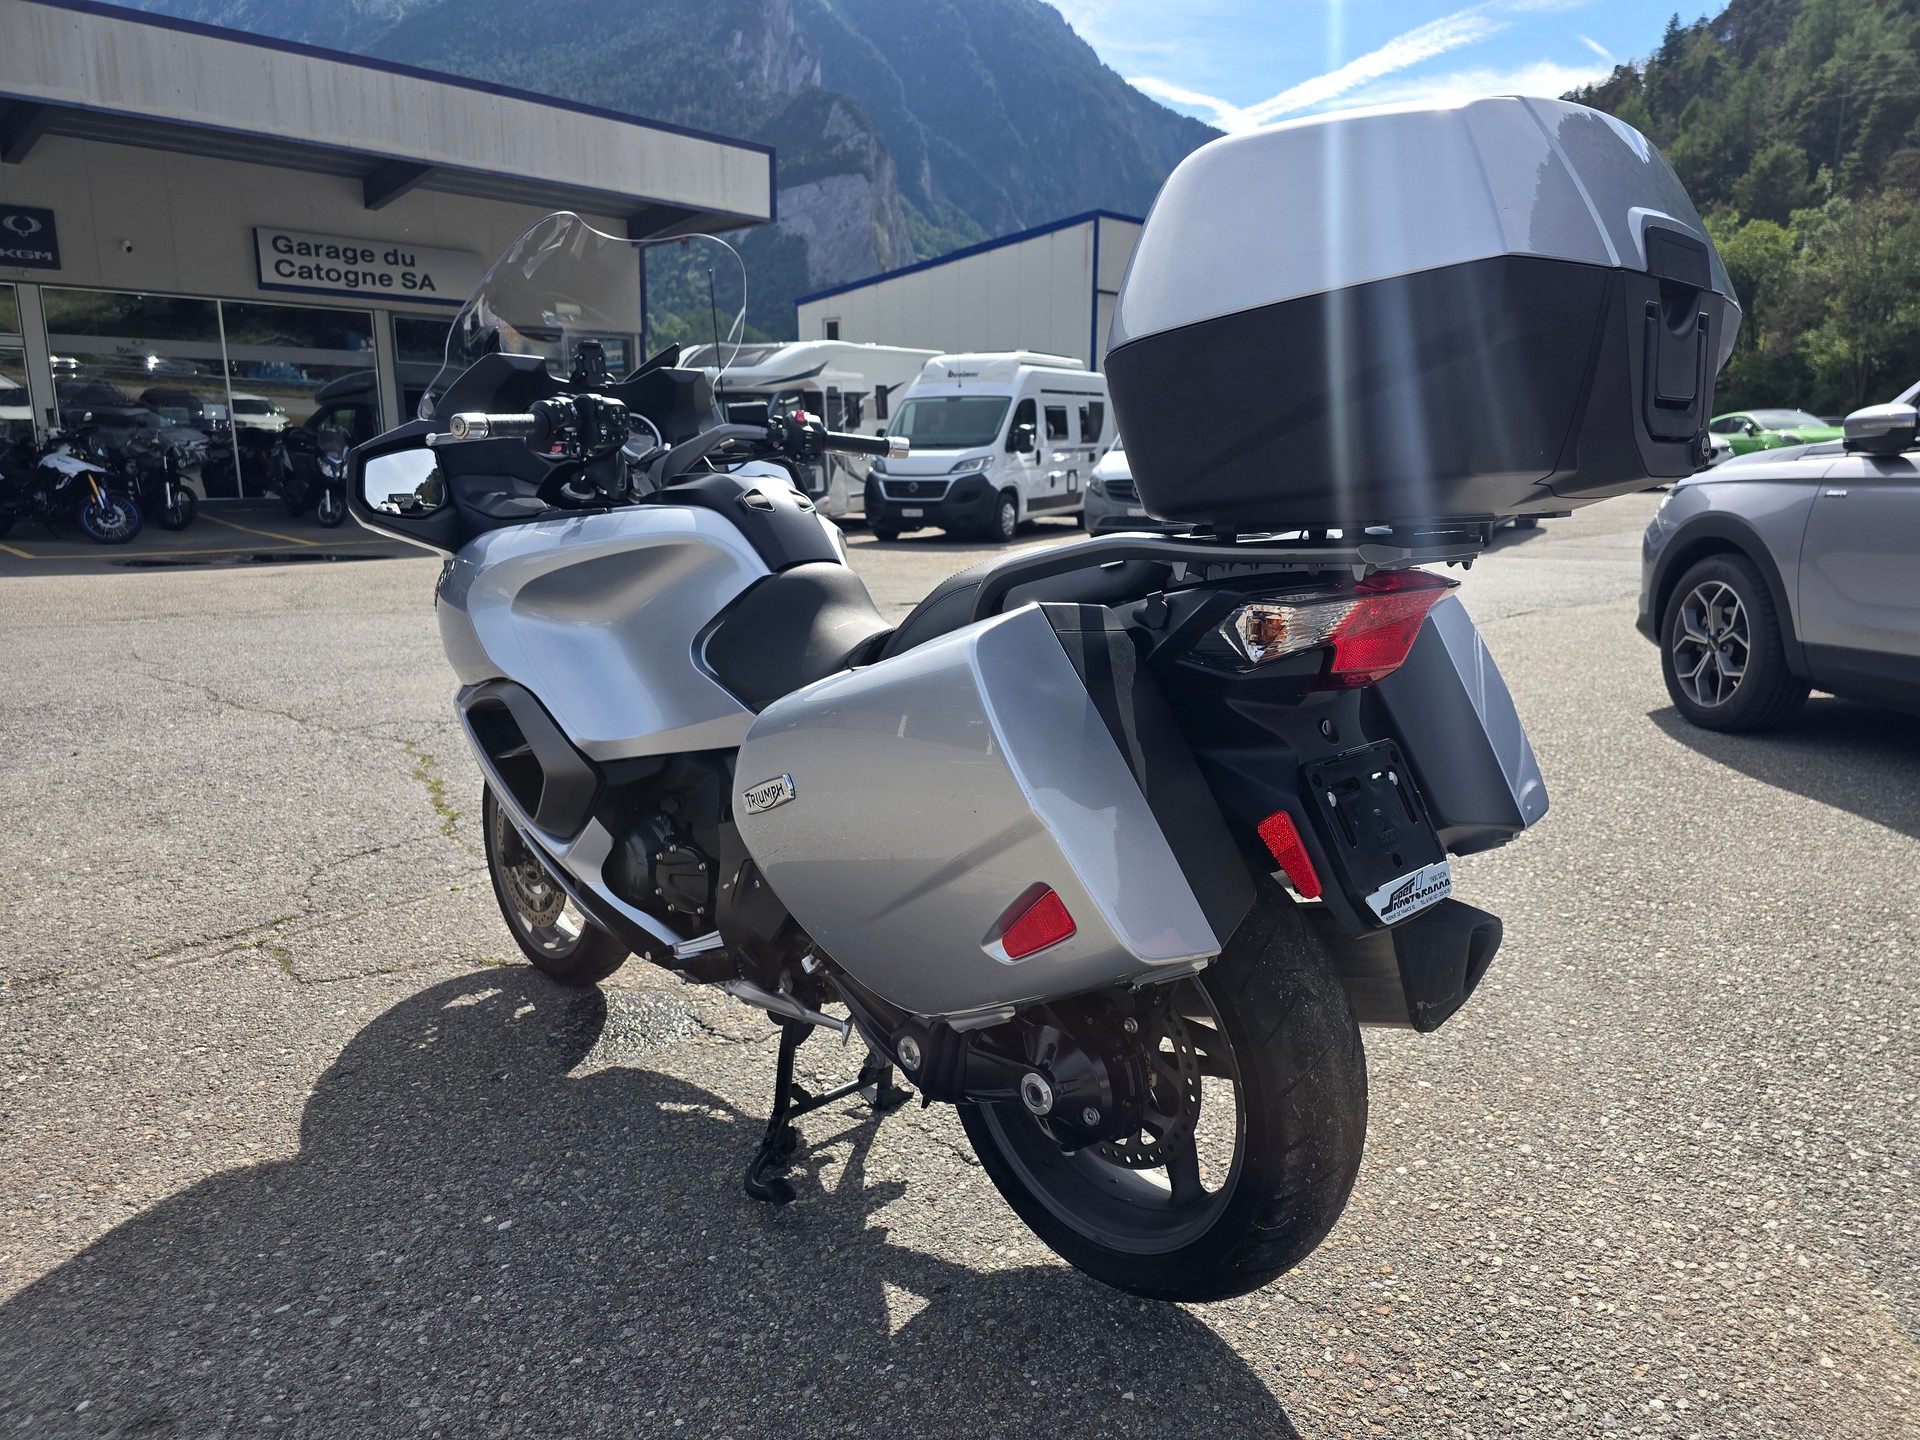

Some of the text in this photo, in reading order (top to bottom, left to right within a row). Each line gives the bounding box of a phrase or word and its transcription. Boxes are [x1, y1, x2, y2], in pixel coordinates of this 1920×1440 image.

[0, 248, 52, 261] KGM
[272, 235, 415, 267] Garage du
[274, 259, 436, 291] Catogne SA
[745, 783, 785, 808] TRIUMPH
